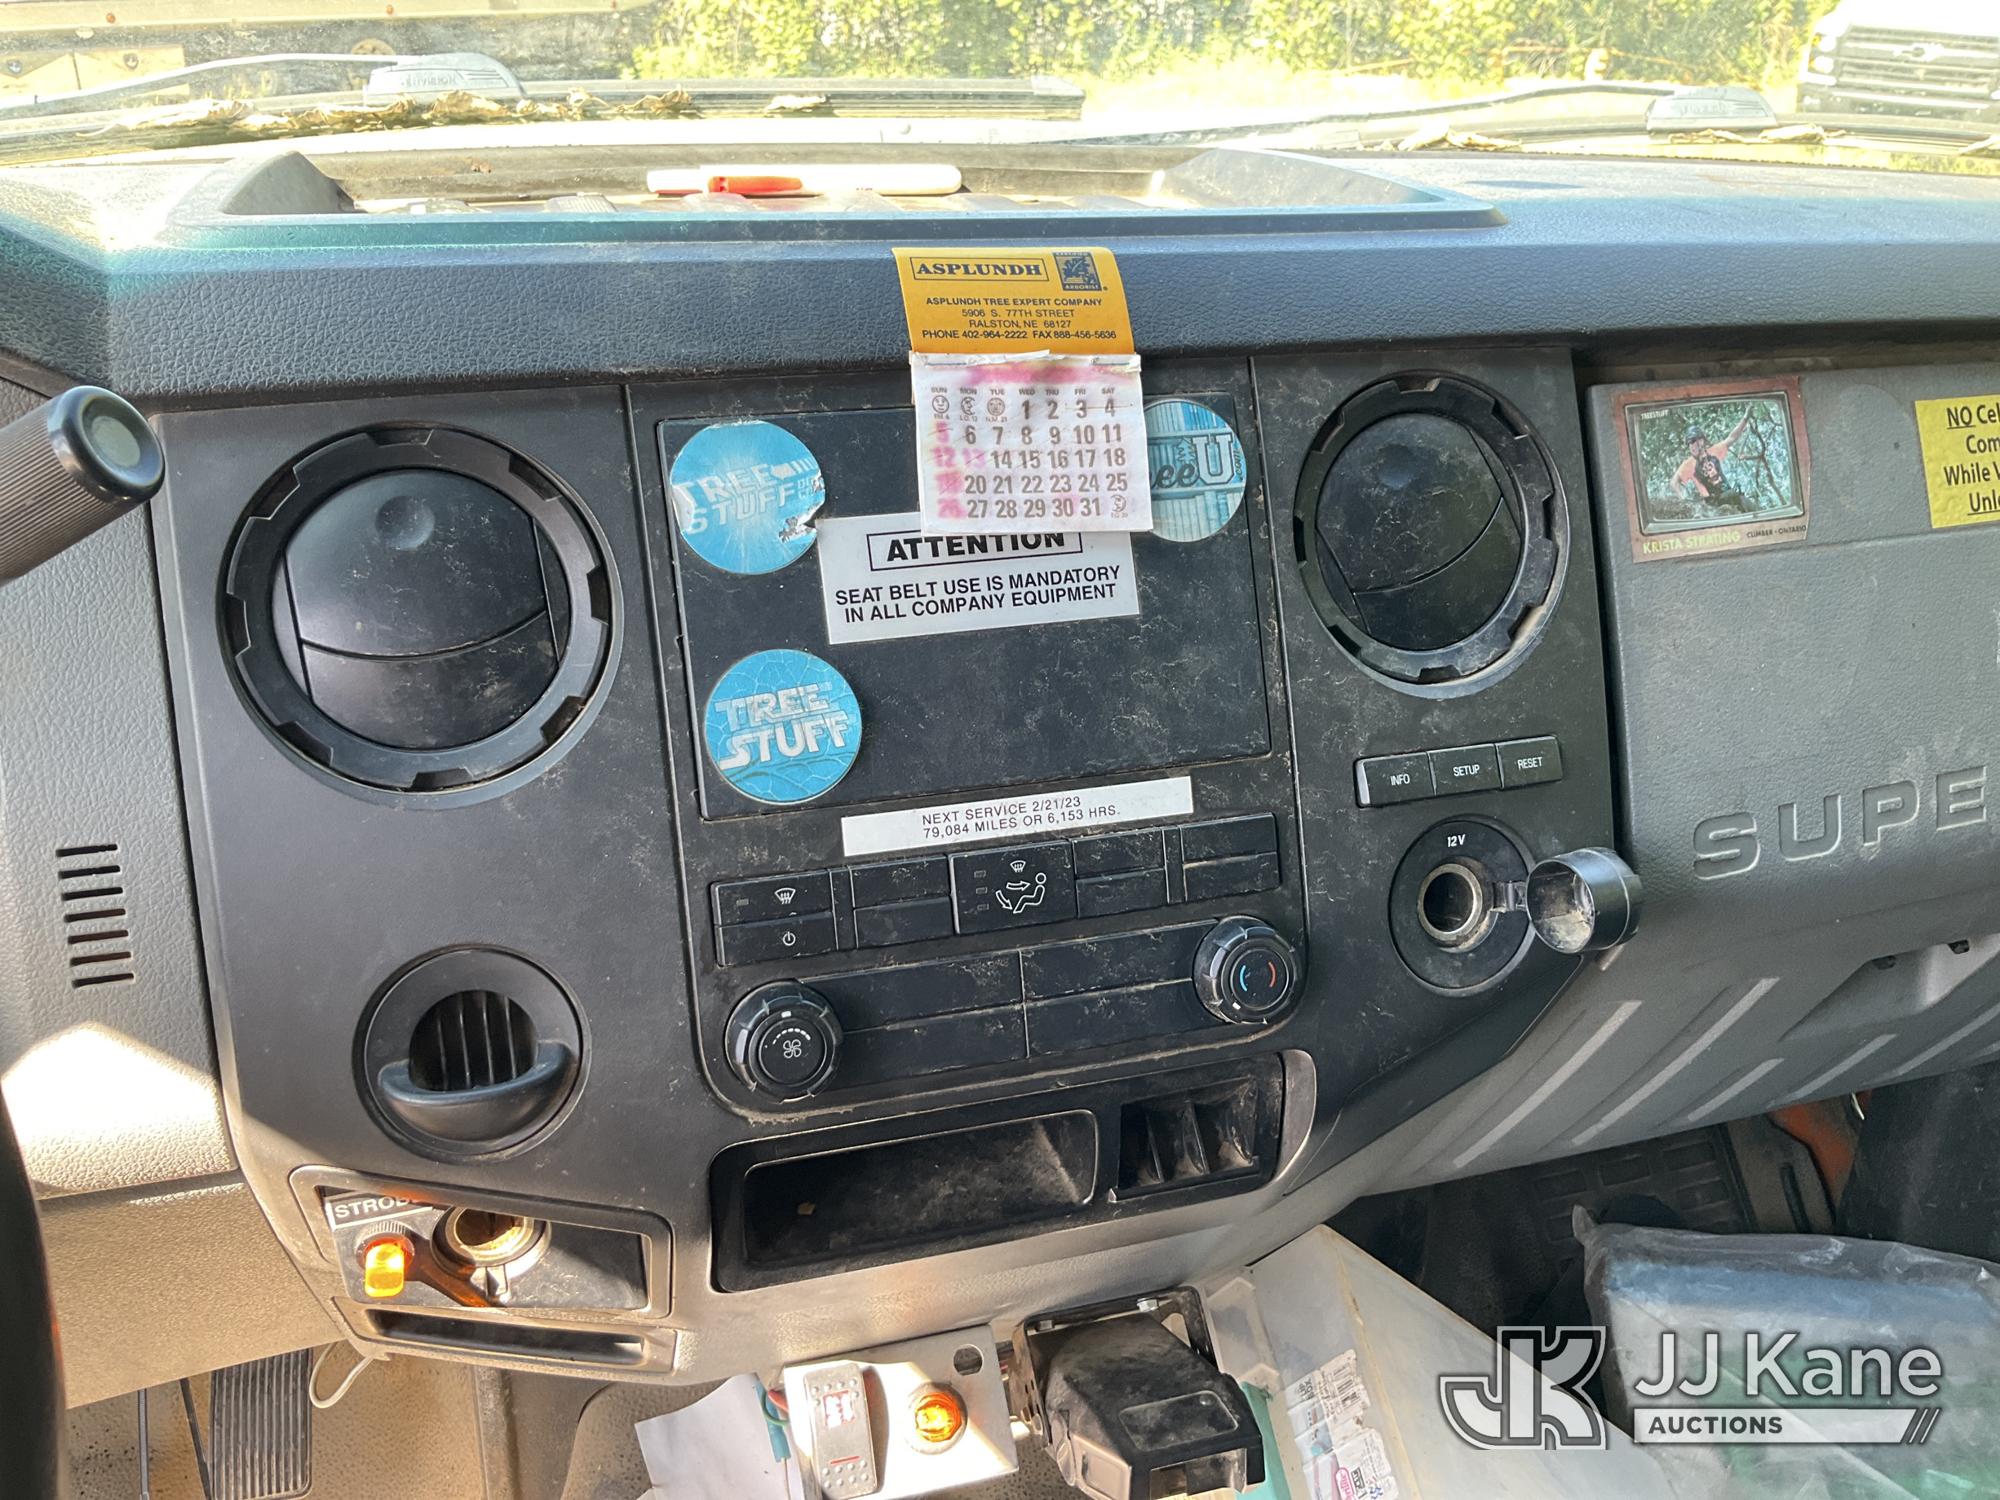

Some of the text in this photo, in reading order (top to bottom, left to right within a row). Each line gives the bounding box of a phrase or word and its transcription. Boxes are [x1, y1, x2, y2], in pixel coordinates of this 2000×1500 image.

[916, 262, 1043, 277] ASPLUNDH
[926, 297, 1102, 306] ASPLUNDH TREE EXPERT COMPANY
[962, 309, 1075, 318] 5906 S. 77TH STREET
[922, 330, 960, 339] PHONE
[961, 330, 1028, 339] 402-964-2222
[1033, 330, 1053, 339] FAX
[969, 320, 1072, 330] RALSTON, NE 68127
[990, 387, 1005, 396] TUE
[1019, 387, 1036, 396] WED
[1045, 387, 1060, 396] THU
[1074, 387, 1087, 396] FRI
[1101, 386, 1115, 395] SAT
[1022, 397, 1116, 420] 1 2 3 4
[1946, 406, 1973, 427] NO
[965, 424, 977, 445] 6
[992, 426, 1004, 445] 7
[1021, 426, 1033, 445] 8
[1049, 426, 1061, 445] 9
[1073, 424, 1096, 445] 10
[1102, 423, 1122, 443] 11
[990, 450, 1013, 469] 14
[1018, 450, 1041, 469] 15
[1047, 449, 1069, 470] 16
[1074, 449, 1096, 468] 17
[1103, 447, 1126, 467] 18
[964, 474, 987, 494] 20
[992, 475, 1014, 494] 21
[1021, 475, 1045, 494] 22
[1049, 474, 1072, 493] 23
[1078, 473, 1101, 493] 24
[1105, 472, 1129, 492] 25
[1944, 462, 1991, 486] While
[966, 499, 988, 518] 27
[995, 499, 1017, 519] 28
[1023, 499, 1046, 518] 29
[1051, 498, 1074, 517] 30
[1080, 497, 1102, 517] 31
[1968, 489, 2000, 512] Unl
[887, 533, 1065, 562] ATTENTION
[1643, 538, 1682, 555] KRISTA
[835, 564, 1121, 606] SEAT BELT USE IS MANDATORY
[844, 583, 1117, 623] IN ALL COMPANY EQUIPMENT
[715, 683, 832, 733] TREE
[718, 710, 850, 771] STUFF
[1452, 764, 1481, 777] SETUP
[1516, 756, 1543, 771] RESET
[1390, 773, 1411, 787] INFO
[922, 795, 1082, 825] NEXT SERVICE 2/21/23
[923, 804, 1121, 840] 79,084 MILES OR 6,153 HRS.
[1447, 833, 1466, 848] 12V
